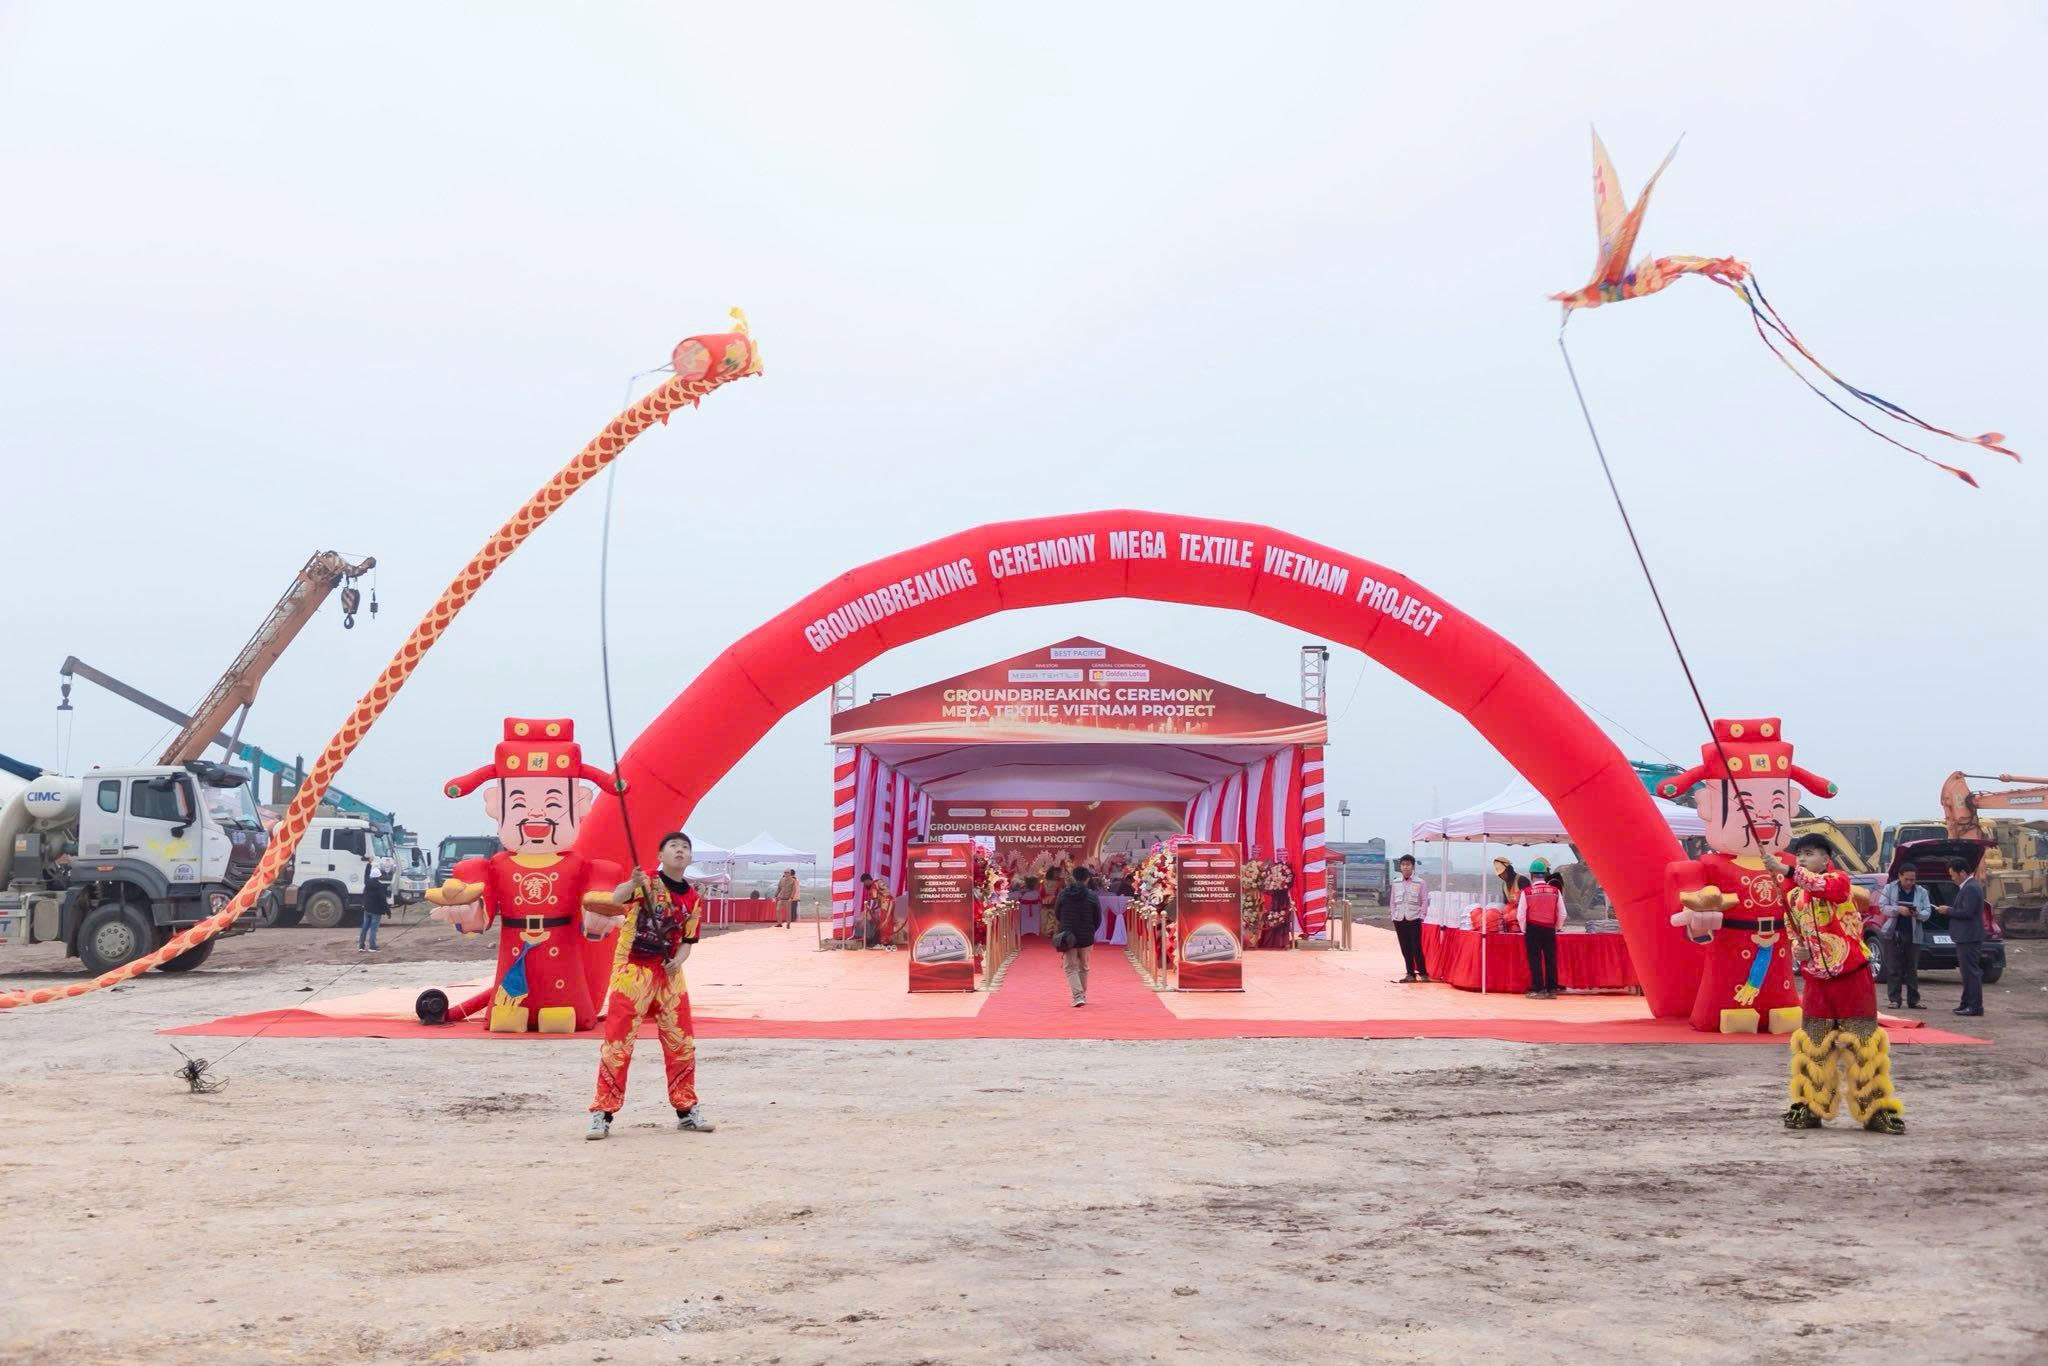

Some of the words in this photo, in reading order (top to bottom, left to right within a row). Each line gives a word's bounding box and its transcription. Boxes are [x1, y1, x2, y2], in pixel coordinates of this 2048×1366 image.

[804, 558, 978, 653] GROUNDBREAKING
[988, 533, 1096, 579] CEREMONY
[1109, 531, 1167, 559] MEGA
[1179, 533, 1254, 568] TEXTILE
[1263, 545, 1349, 595] VIETNAM
[1356, 577, 1442, 637] PROJECT
[943, 688, 1111, 701] GROUNDBREAKING
[1115, 688, 1214, 701] CEREMONY
[942, 704, 990, 717] MEGA
[994, 704, 1058, 717] TEXTILE
[1063, 704, 1137, 717] VIETNAM
[1142, 704, 1216, 717] PROJECT
[27, 792, 61, 801] CIMC
[930, 823, 1027, 832] GROUNDBREAKING
[1029, 823, 1086, 832] CEREMONY
[929, 835, 943, 843] ME
[999, 835, 1042, 843] VIETNAM
[1044, 835, 1087, 843] PROJECT
